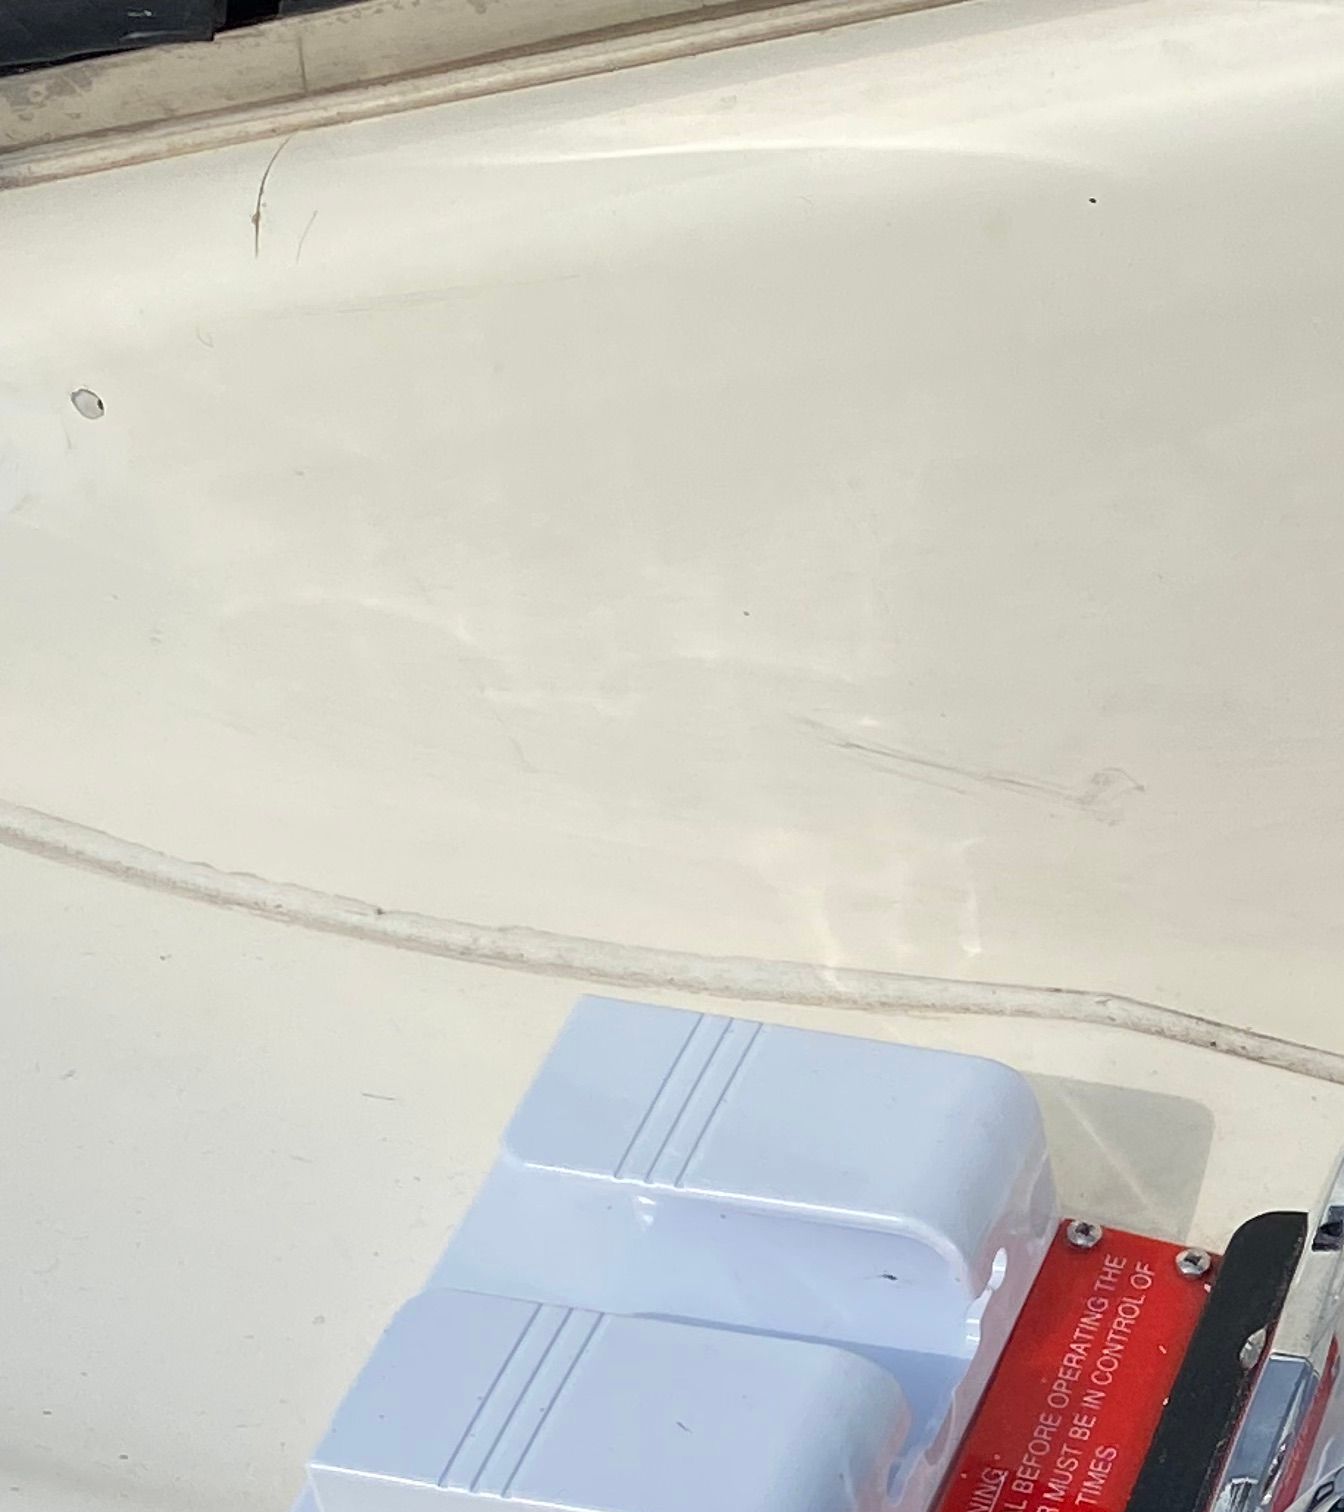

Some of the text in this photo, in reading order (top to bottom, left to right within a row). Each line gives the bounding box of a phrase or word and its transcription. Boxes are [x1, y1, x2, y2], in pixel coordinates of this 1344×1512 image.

[1131, 1261, 1157, 1288] OF
[1092, 1292, 1144, 1384] CONTROL
[1012, 1412, 1059, 1491] BEFORE
[1047, 1296, 1107, 1407] OPERATING
[1095, 1254, 1124, 1291] THE
[1082, 1388, 1105, 1407] IN
[1070, 1413, 1095, 1438] BE
[1045, 1445, 1082, 1500] MUST
[1077, 1445, 1117, 1507] TIMES
